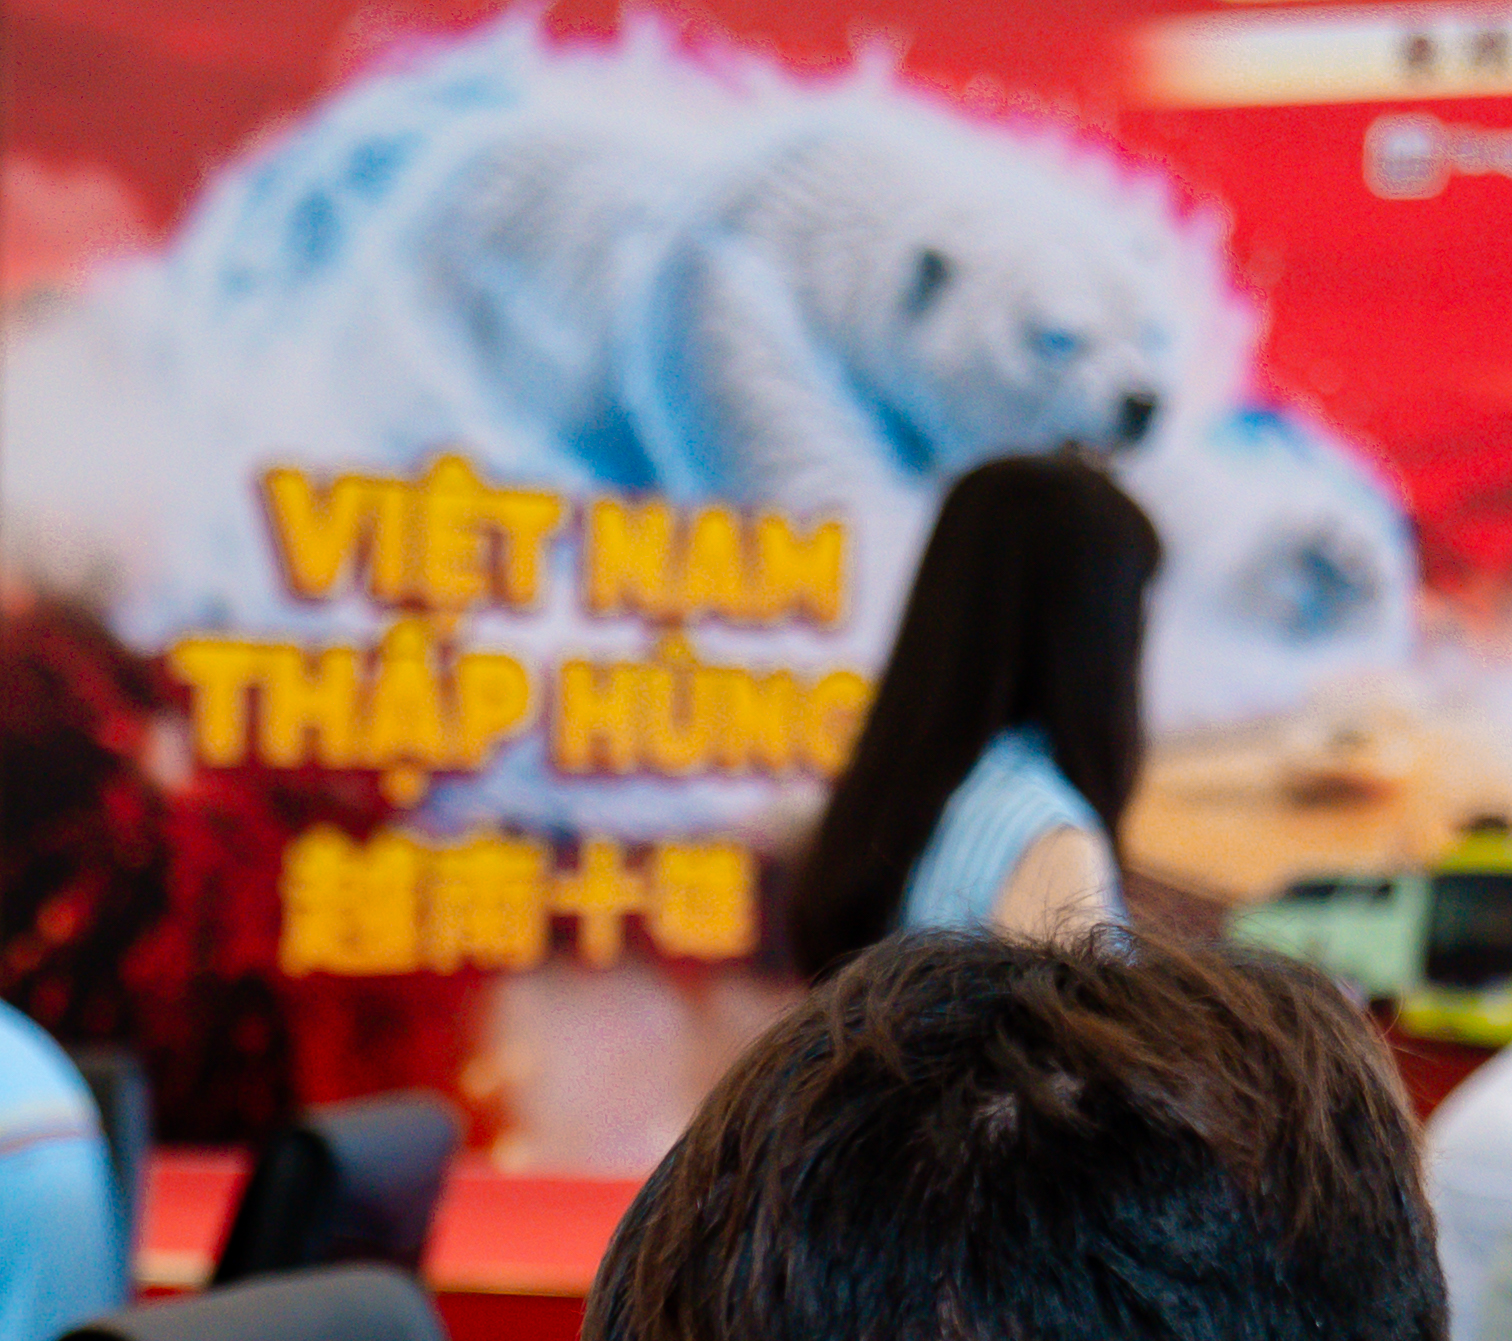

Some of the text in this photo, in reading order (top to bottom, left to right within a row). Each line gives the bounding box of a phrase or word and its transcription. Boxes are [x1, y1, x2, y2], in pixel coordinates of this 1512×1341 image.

[261, 454, 846, 632] VIỆT NAM
[173, 616, 532, 805] THẬP
